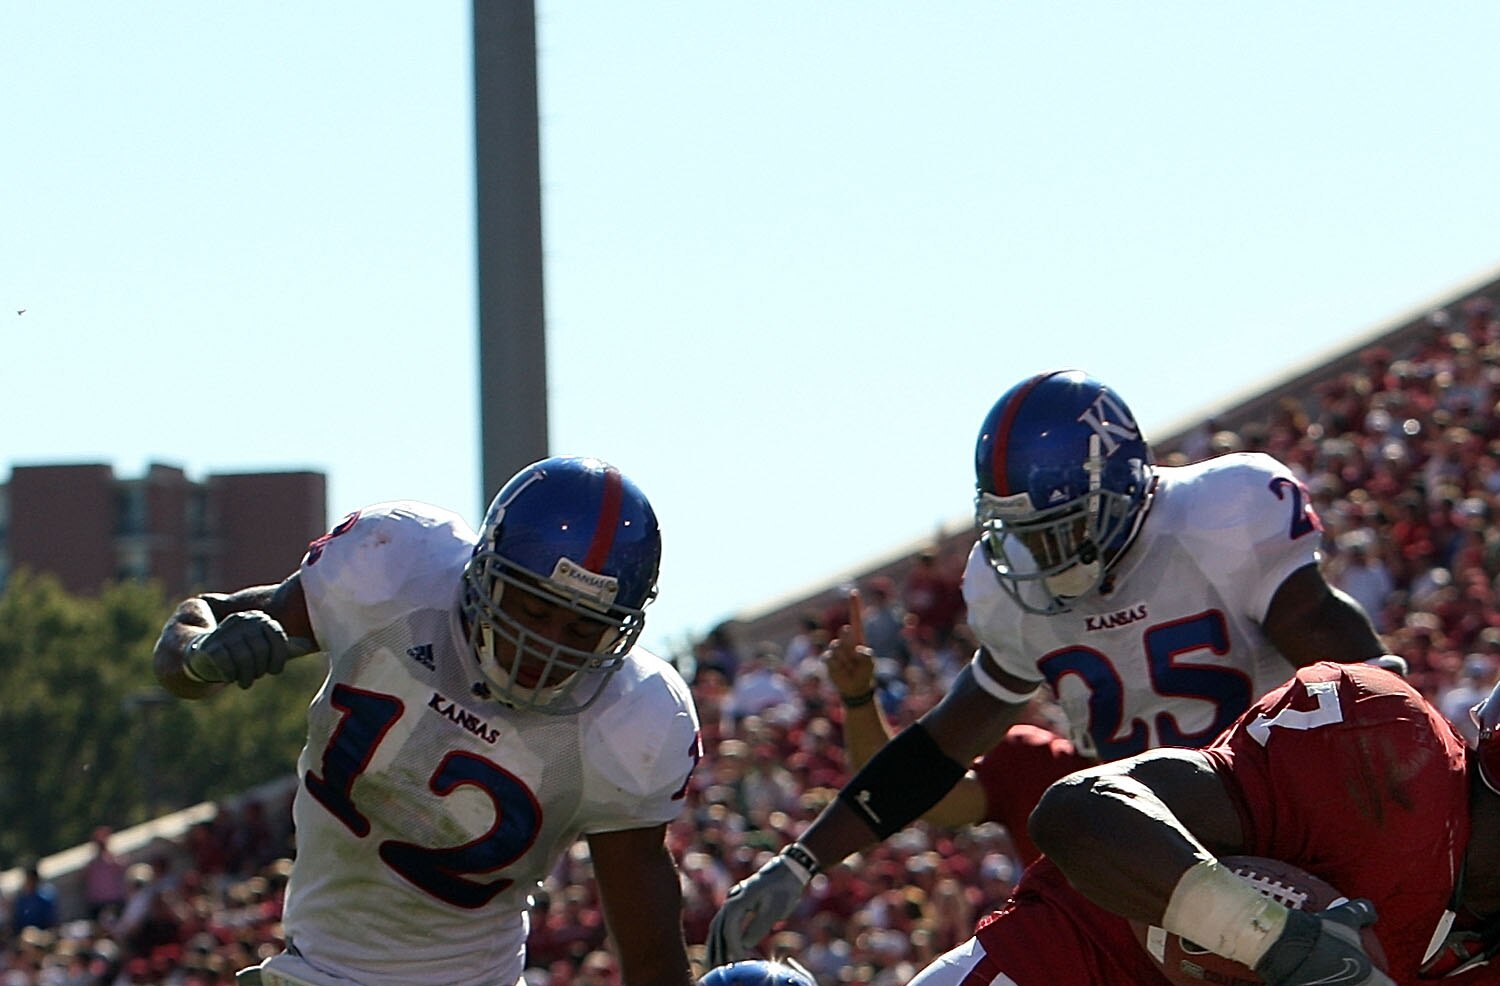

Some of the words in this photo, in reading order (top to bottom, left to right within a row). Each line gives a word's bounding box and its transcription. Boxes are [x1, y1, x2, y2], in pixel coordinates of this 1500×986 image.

[1085, 604, 1148, 631] KANSAS
[428, 692, 500, 744] KANSAS
[1036, 608, 1254, 763] 25
[304, 683, 544, 909] 12
